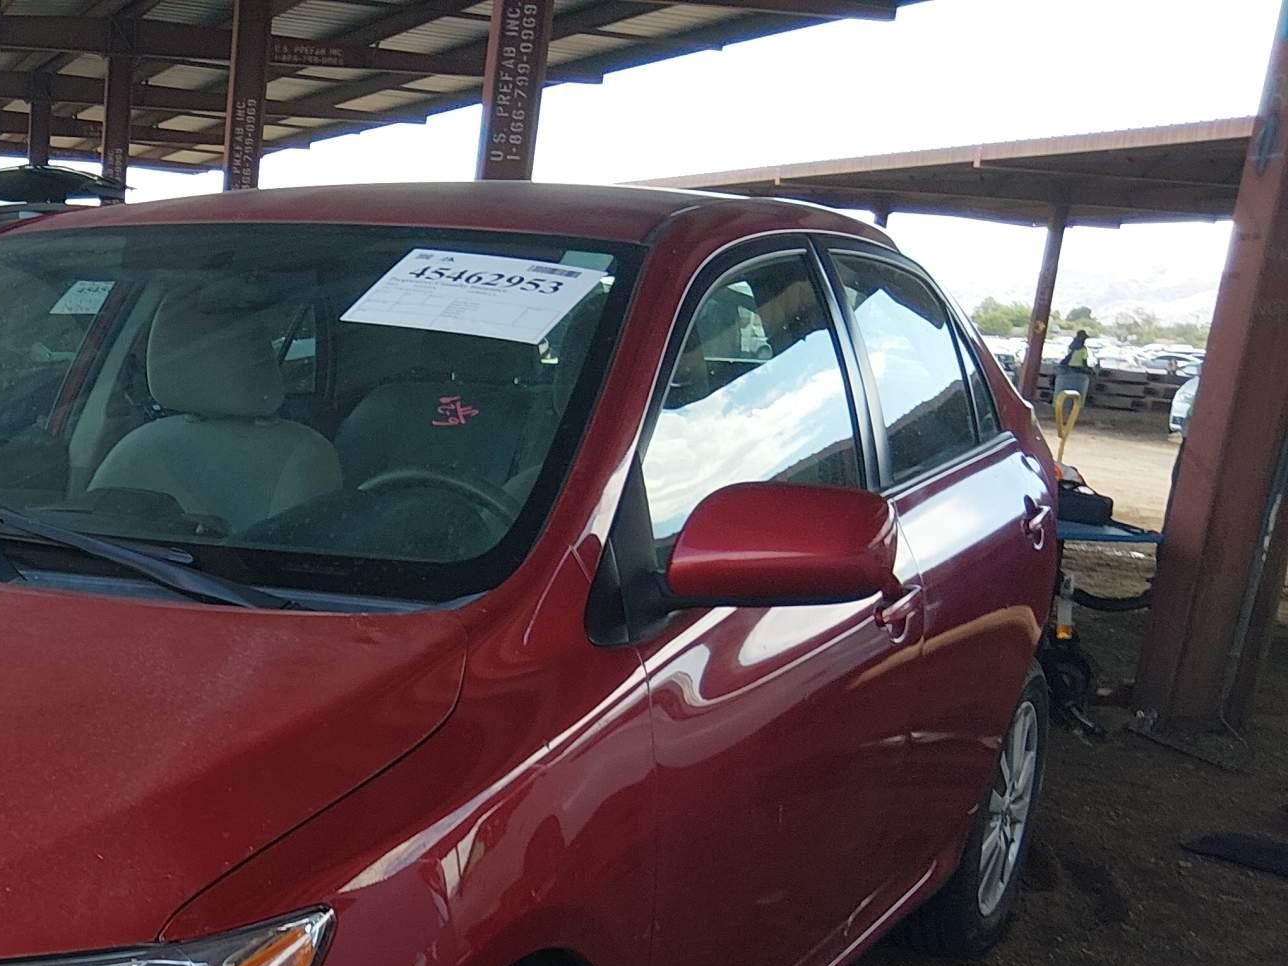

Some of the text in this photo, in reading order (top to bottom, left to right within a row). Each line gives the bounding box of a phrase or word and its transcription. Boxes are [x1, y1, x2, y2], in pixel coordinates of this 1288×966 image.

[496, 46, 518, 118] PREFAB
[506, 4, 538, 161] 1-866-799-0969
[409, 265, 564, 295] 45462953
